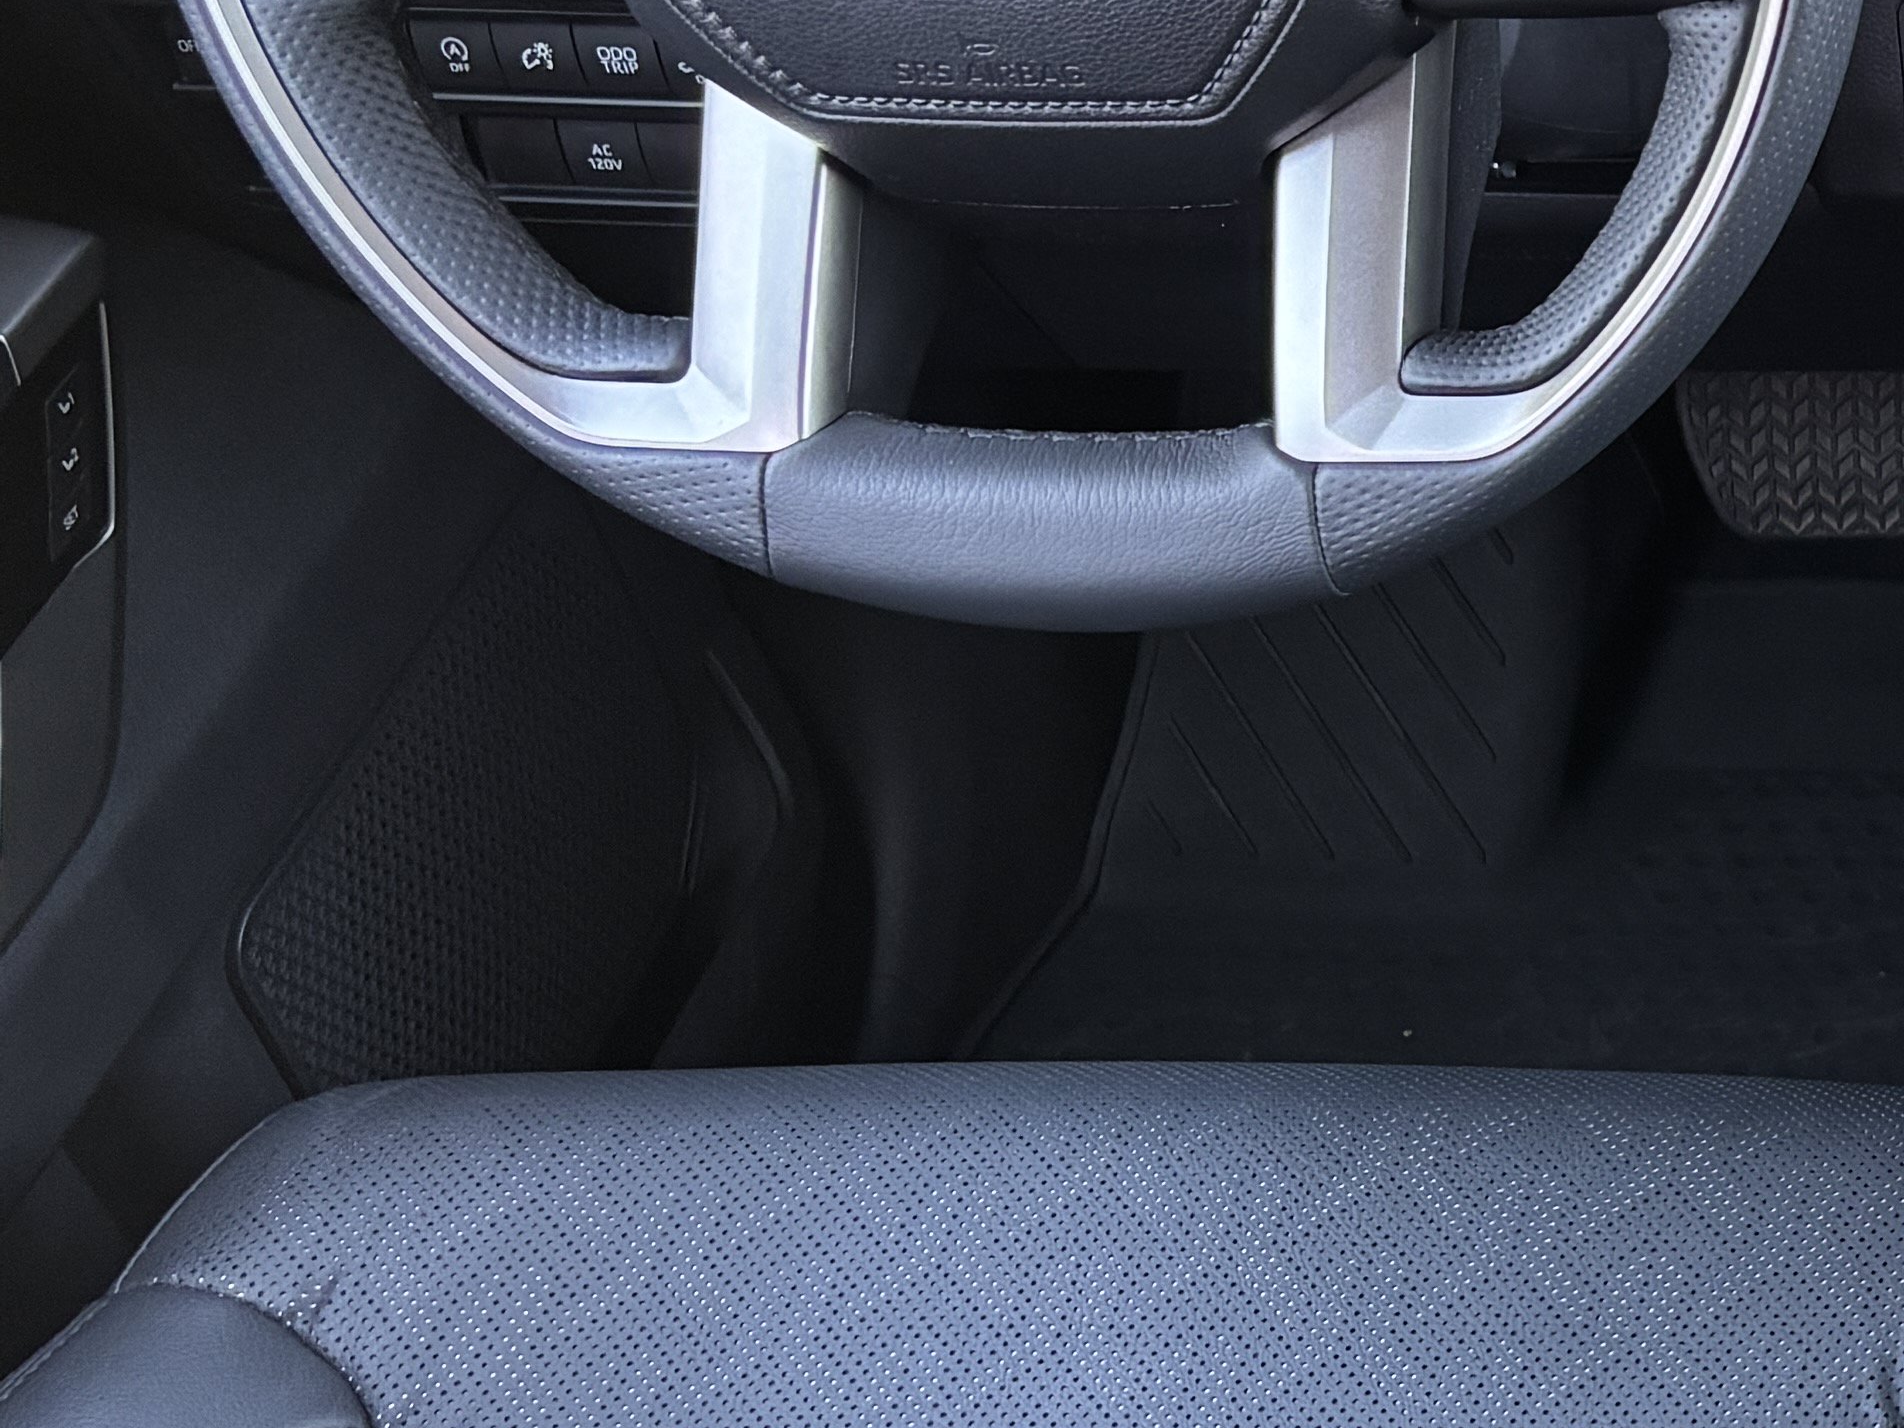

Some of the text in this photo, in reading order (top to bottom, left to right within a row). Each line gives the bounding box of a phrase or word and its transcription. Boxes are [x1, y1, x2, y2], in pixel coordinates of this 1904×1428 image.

[596, 45, 637, 62] ODO
[449, 63, 471, 74] OFF
[600, 60, 639, 75] TRIP
[592, 143, 613, 157] AC
[587, 156, 623, 171] 120V
